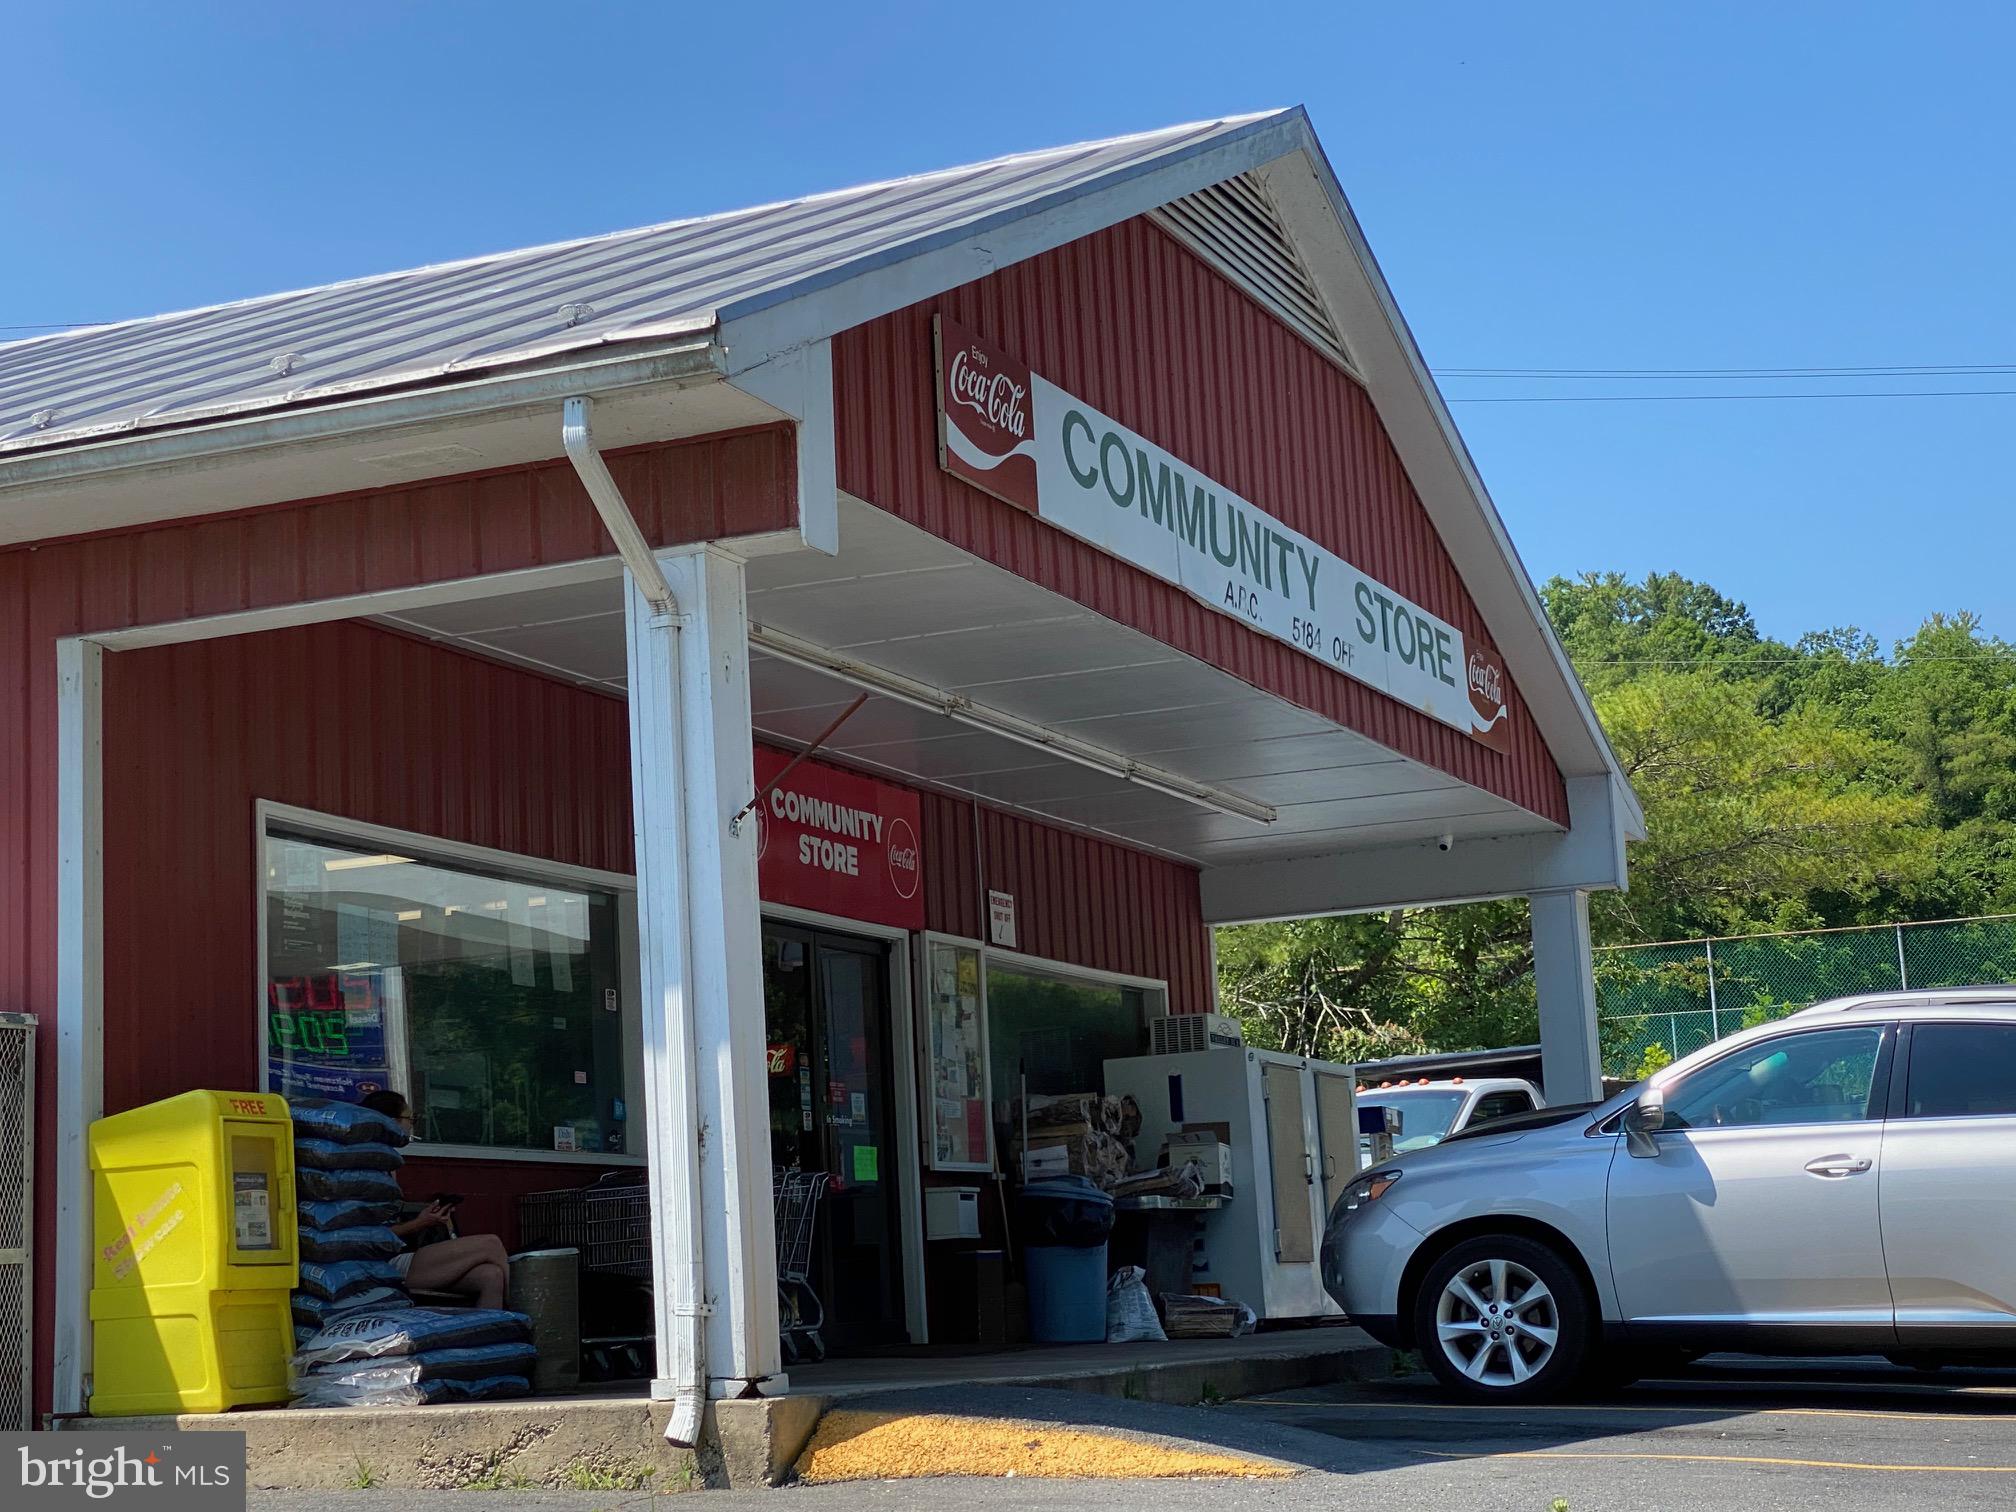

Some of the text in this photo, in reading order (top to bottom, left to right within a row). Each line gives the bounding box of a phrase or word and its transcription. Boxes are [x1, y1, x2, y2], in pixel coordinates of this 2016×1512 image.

[971, 345, 988, 368] Enjoy
[950, 351, 1026, 437] Coca-Cola
[1062, 410, 1455, 688] COMMUNITY STORE
[1292, 616, 1321, 652] 5184
[771, 788, 883, 843] COMMUNITY
[799, 834, 858, 876] STORE
[890, 844, 915, 871] Coca-Cola
[231, 1099, 267, 1115] FREE
